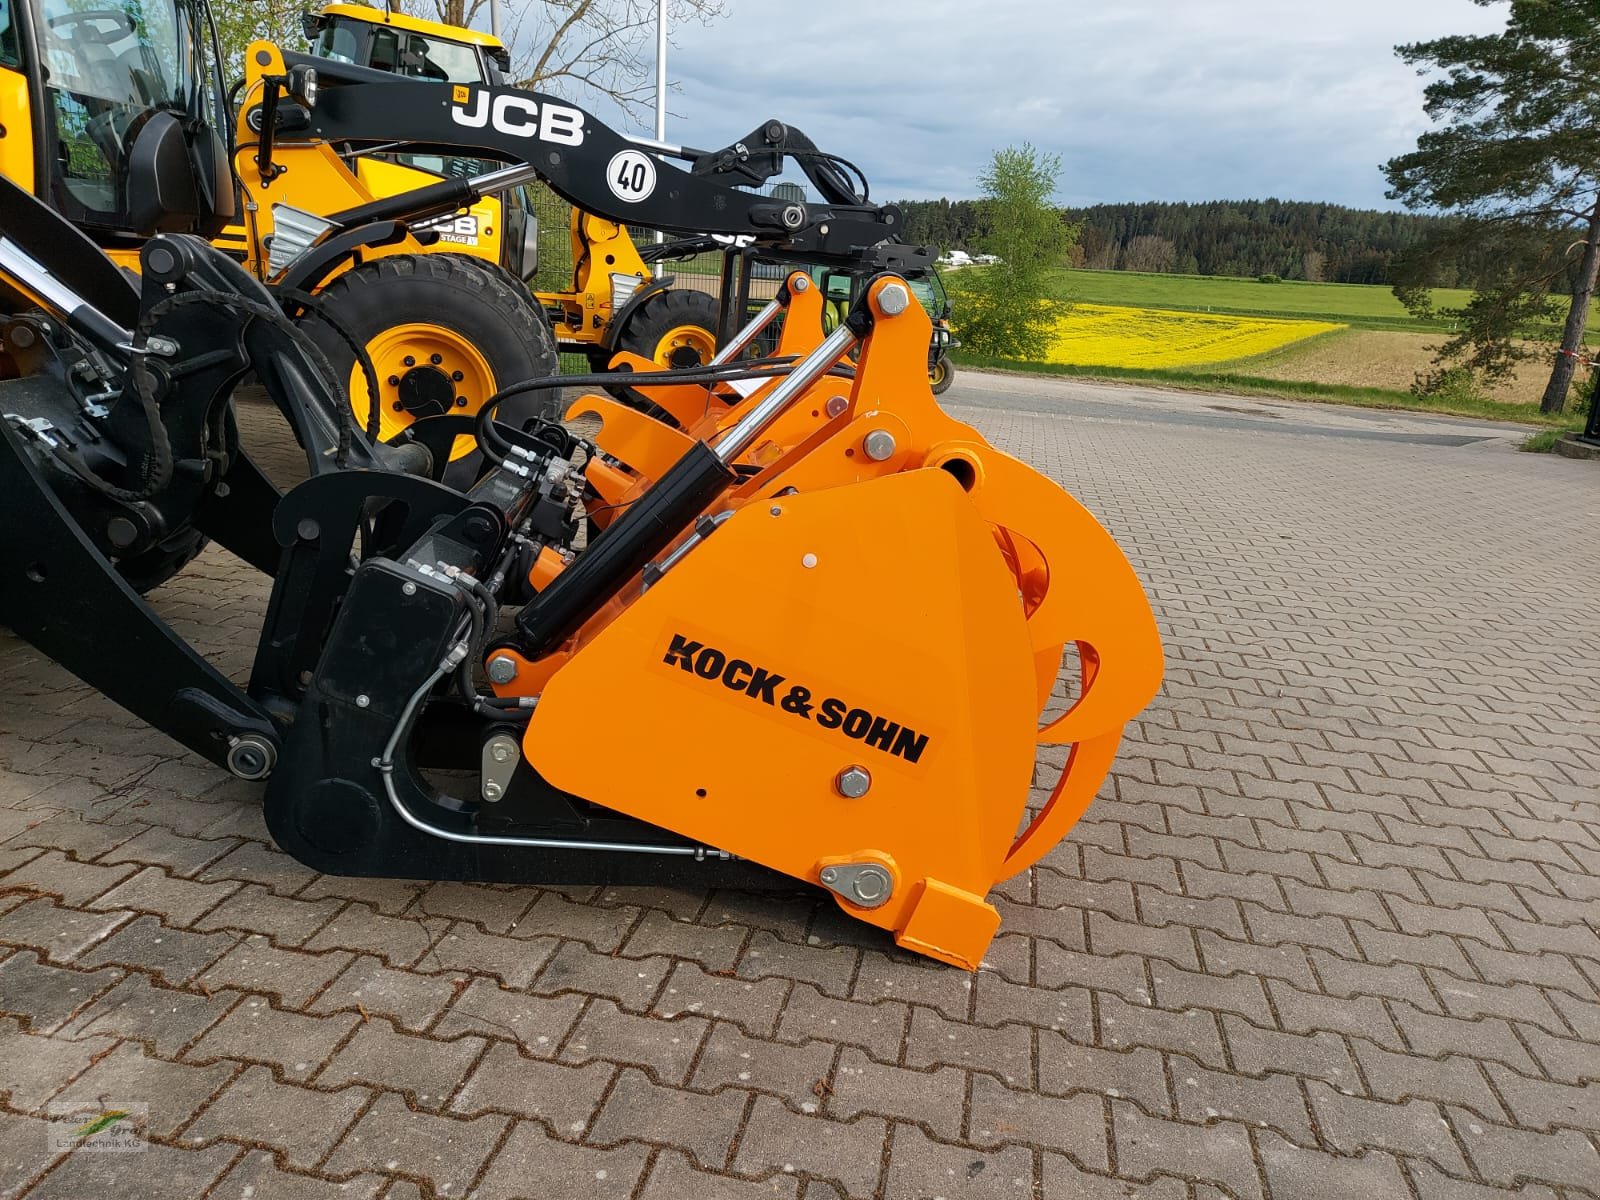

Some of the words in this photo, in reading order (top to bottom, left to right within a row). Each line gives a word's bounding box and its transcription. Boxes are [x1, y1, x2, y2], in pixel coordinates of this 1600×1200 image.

[451, 90, 585, 146] JCB
[617, 160, 646, 192] 40
[441, 234, 467, 244] STAGE
